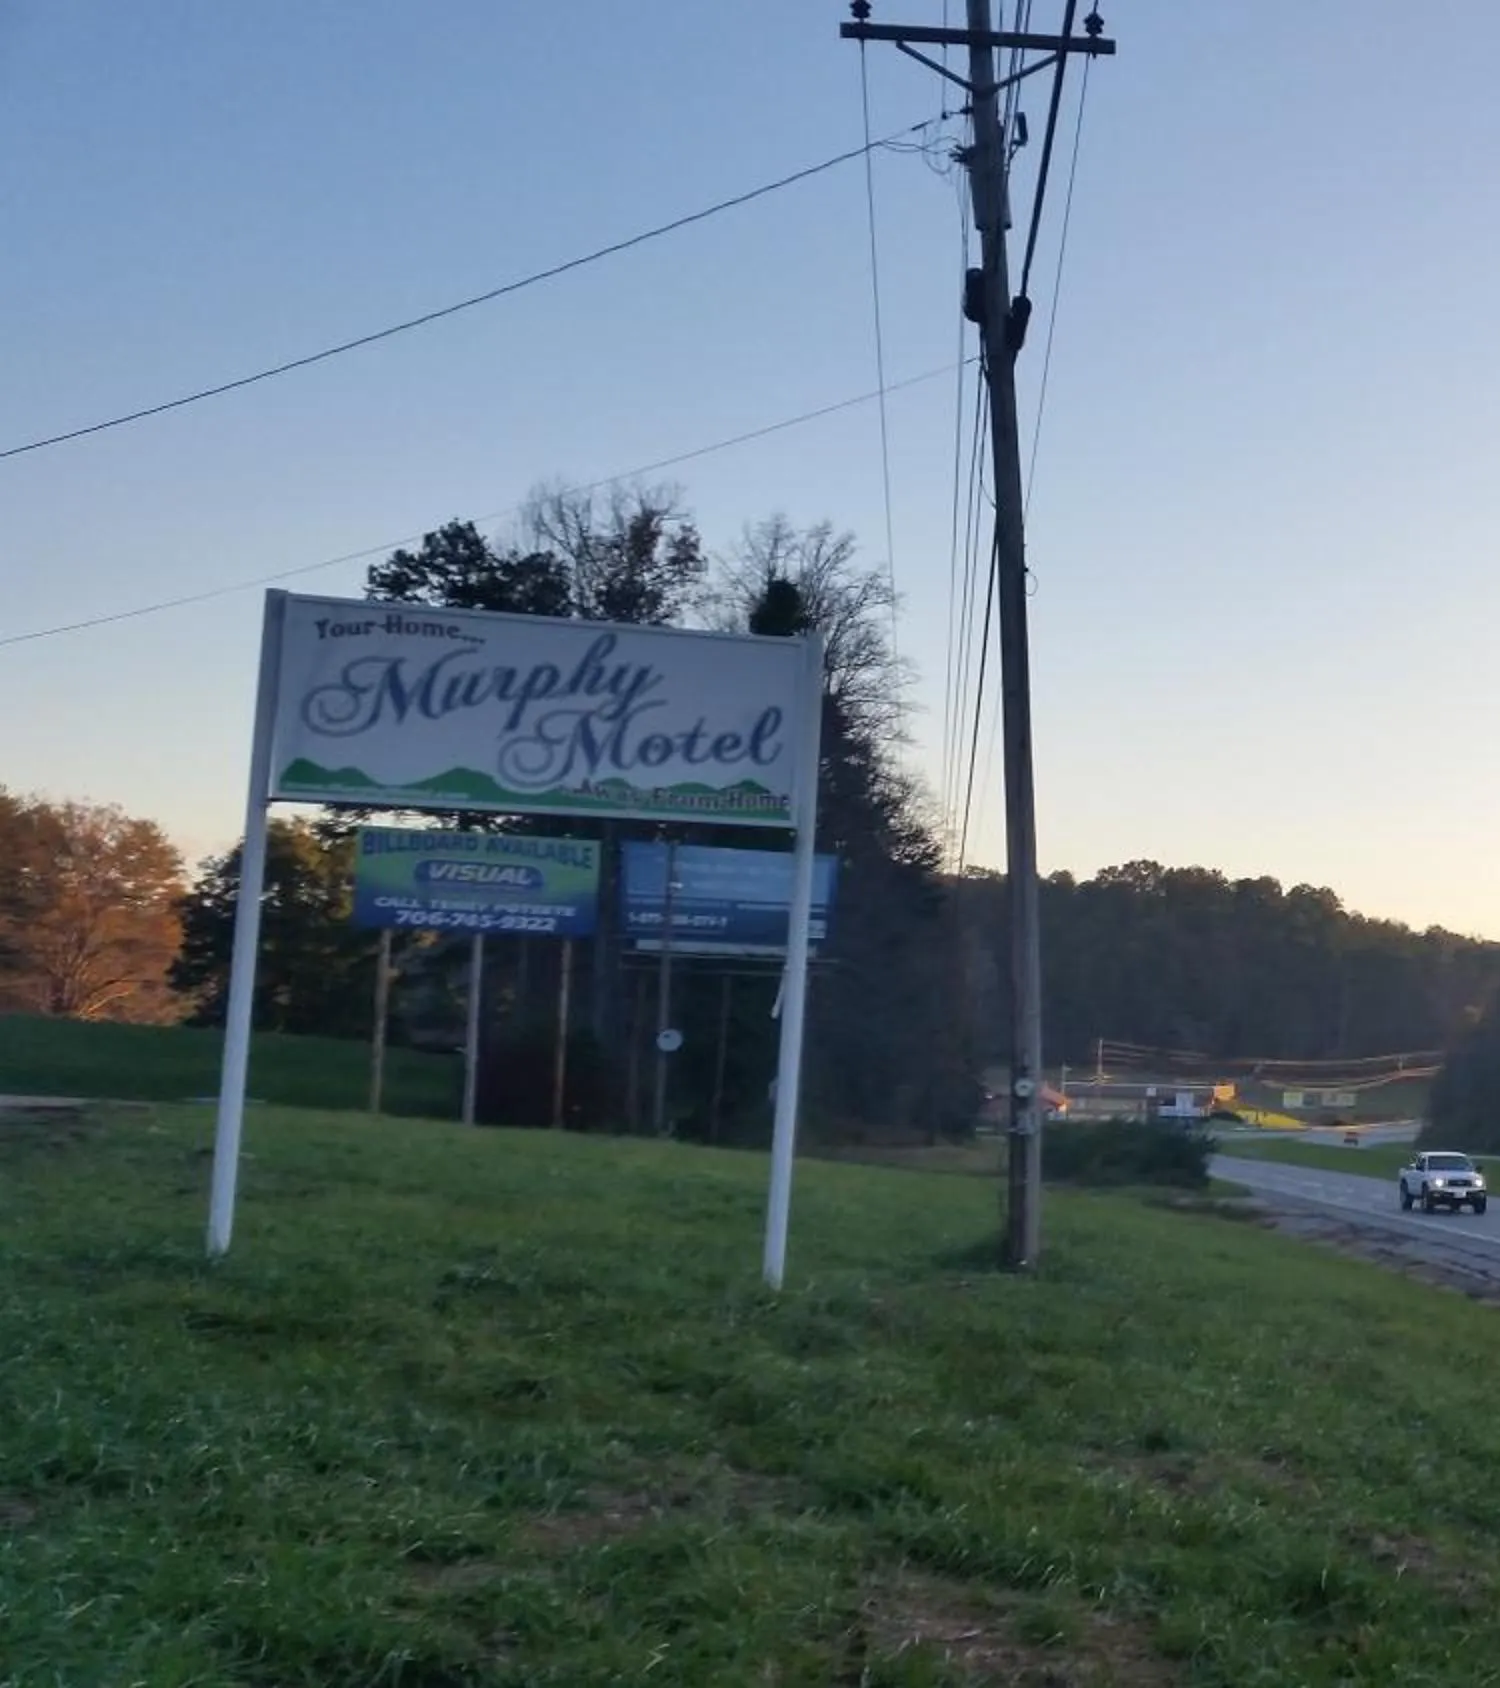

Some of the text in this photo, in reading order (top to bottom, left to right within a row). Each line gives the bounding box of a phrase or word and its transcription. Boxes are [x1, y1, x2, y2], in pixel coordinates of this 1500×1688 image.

[314, 617, 378, 639] Your
[301, 632, 665, 739] Murphy
[497, 699, 784, 788] Motel
[362, 831, 594, 870] BILLBOARD AVAILABLE
[428, 862, 533, 886] VISUAL
[373, 896, 421, 909] CALL
